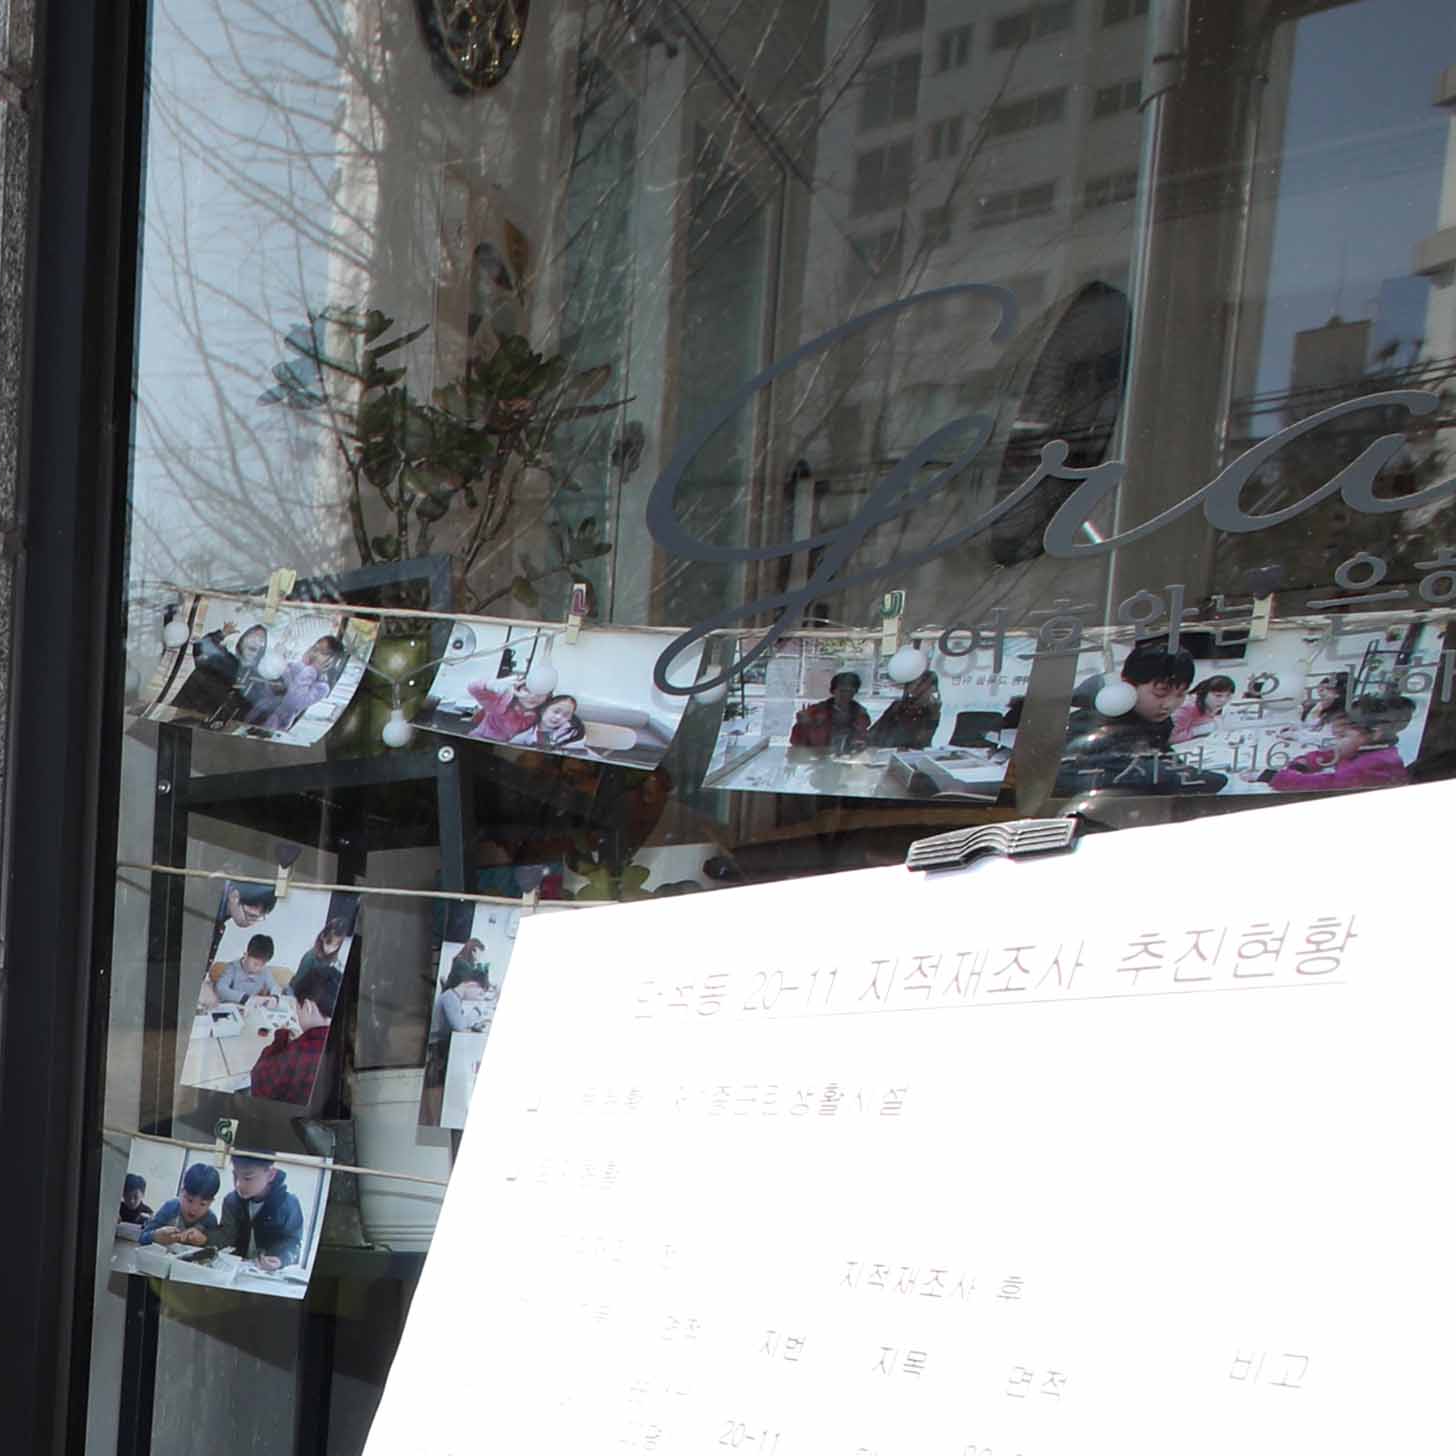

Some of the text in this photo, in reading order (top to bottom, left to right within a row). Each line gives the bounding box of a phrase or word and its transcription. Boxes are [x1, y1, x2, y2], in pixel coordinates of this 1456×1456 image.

[646, 282, 1456, 696] Gra
[740, 966, 840, 1010] 20-11
[856, 938, 1088, 1008] 지적재조사
[1116, 912, 1360, 988] 추진현황
[840, 1257, 978, 1304] 지적재조사
[872, 1344, 929, 1382] 지목
[1003, 1364, 1072, 1406] 면적
[1226, 1346, 1311, 1391] 비고
[717, 1418, 782, 1456] 20-11
